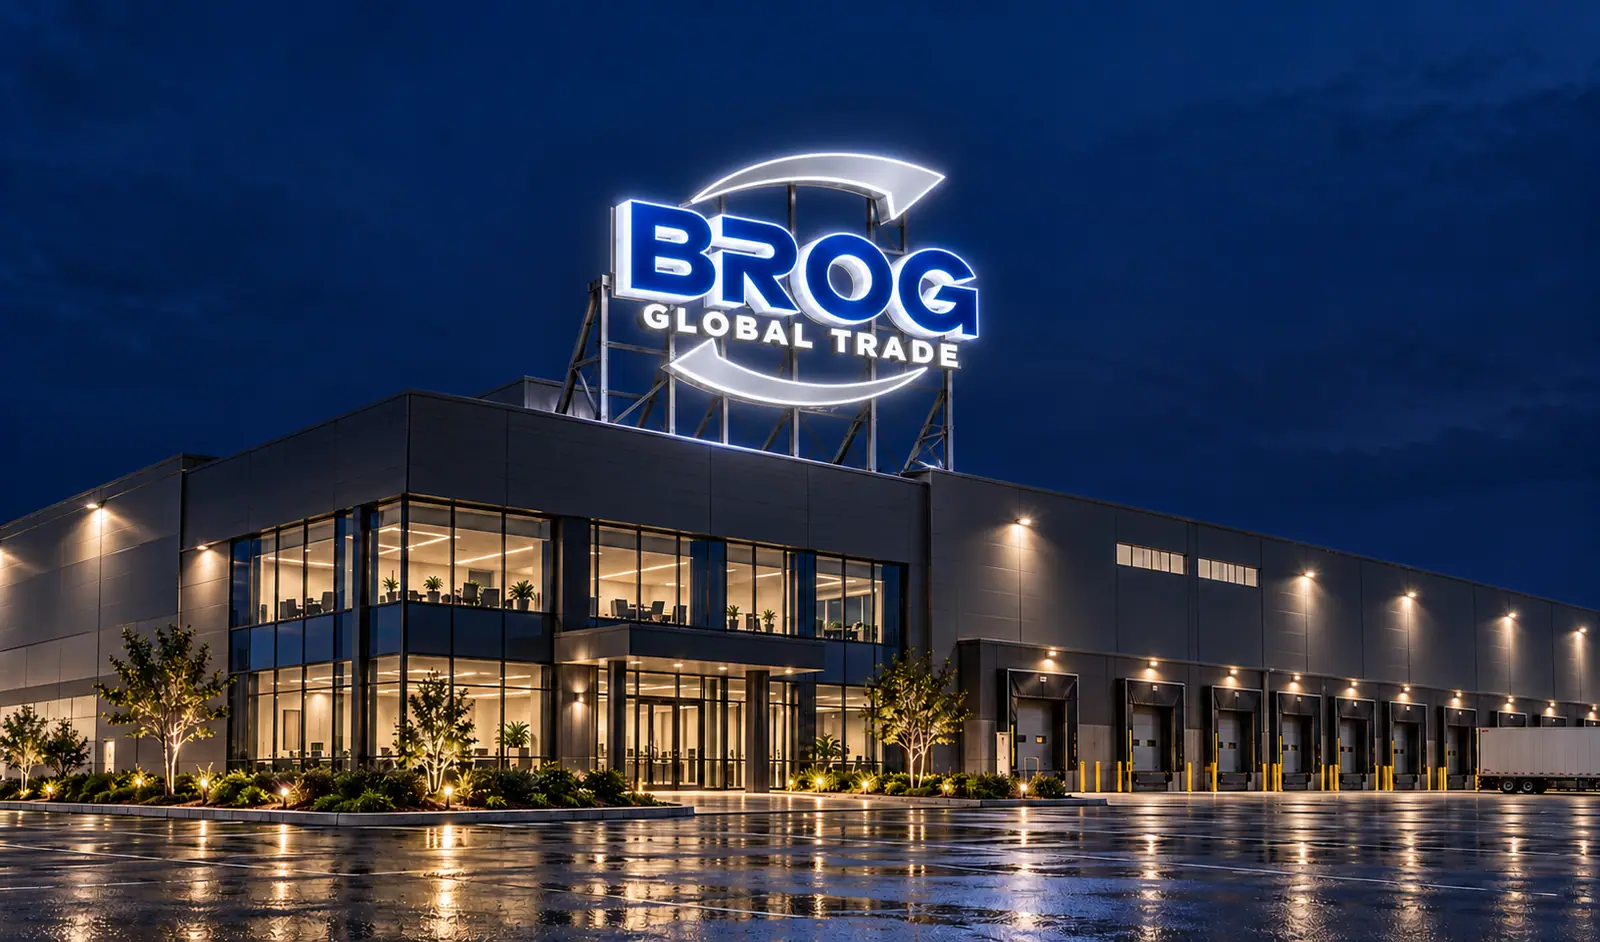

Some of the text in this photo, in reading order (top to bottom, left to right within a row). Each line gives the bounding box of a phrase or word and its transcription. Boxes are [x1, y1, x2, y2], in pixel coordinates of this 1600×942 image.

[617, 199, 979, 340] BROG
[643, 304, 960, 368] GLOBAL TRADE
